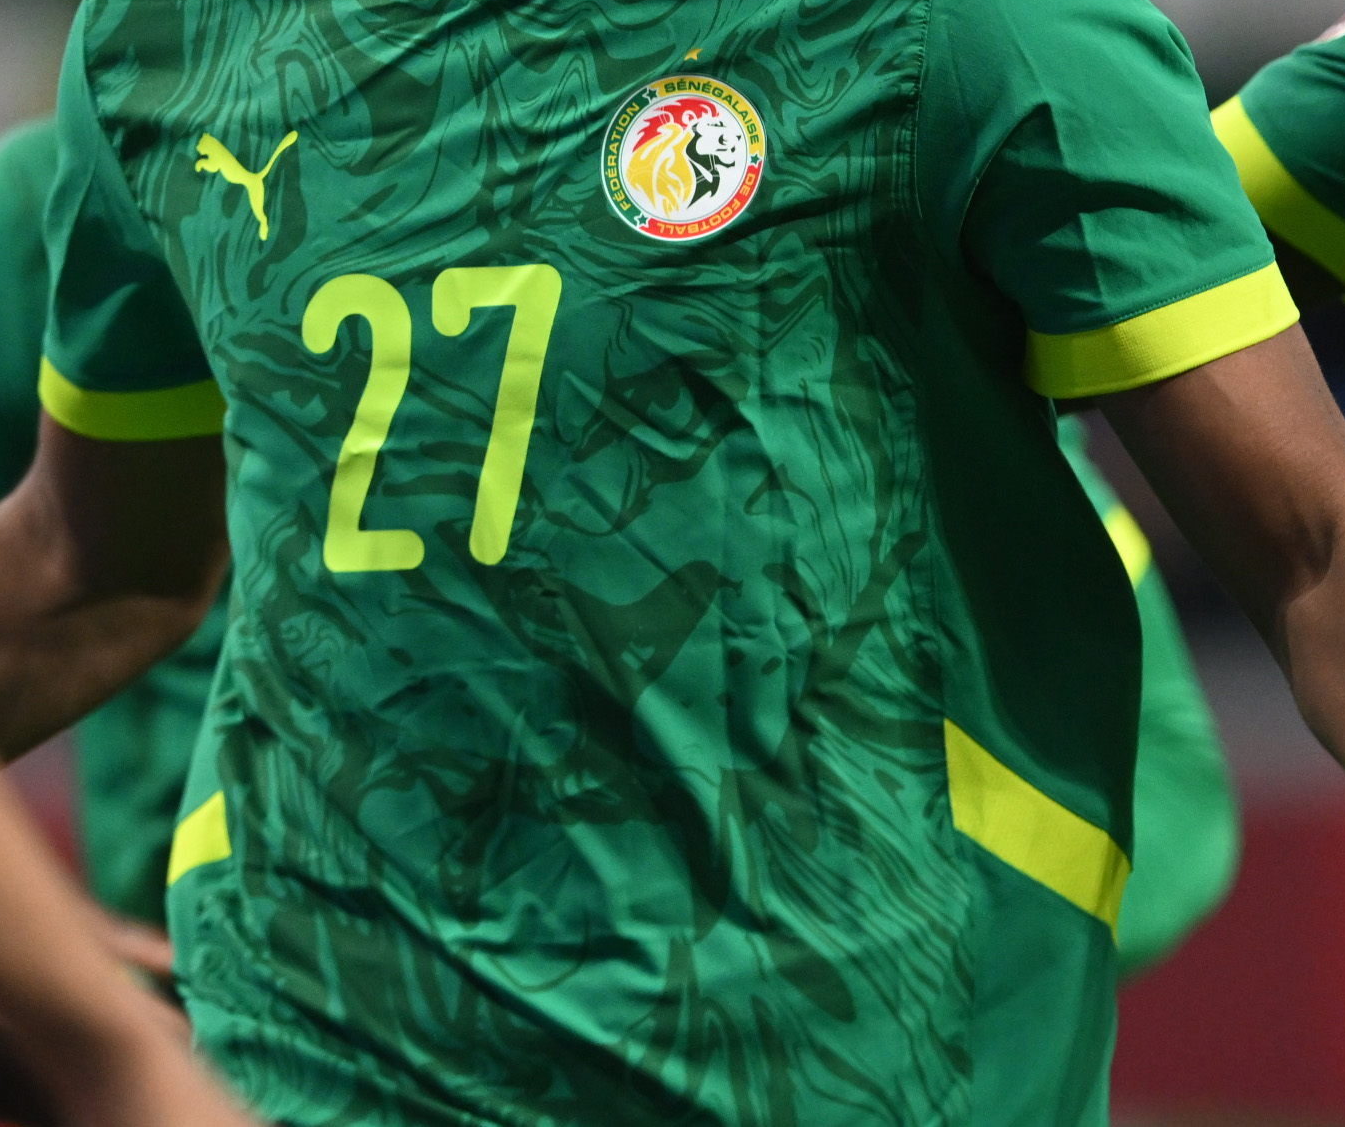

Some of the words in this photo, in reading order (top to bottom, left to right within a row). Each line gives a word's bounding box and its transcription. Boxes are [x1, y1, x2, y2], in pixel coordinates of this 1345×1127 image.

[665, 79, 760, 144] SÉNÉGALAISE
[607, 102, 640, 211] FÉDÉRATION
[741, 173, 755, 197] DE
[656, 199, 743, 235] FOOTBALL
[301, 263, 563, 573] 27
